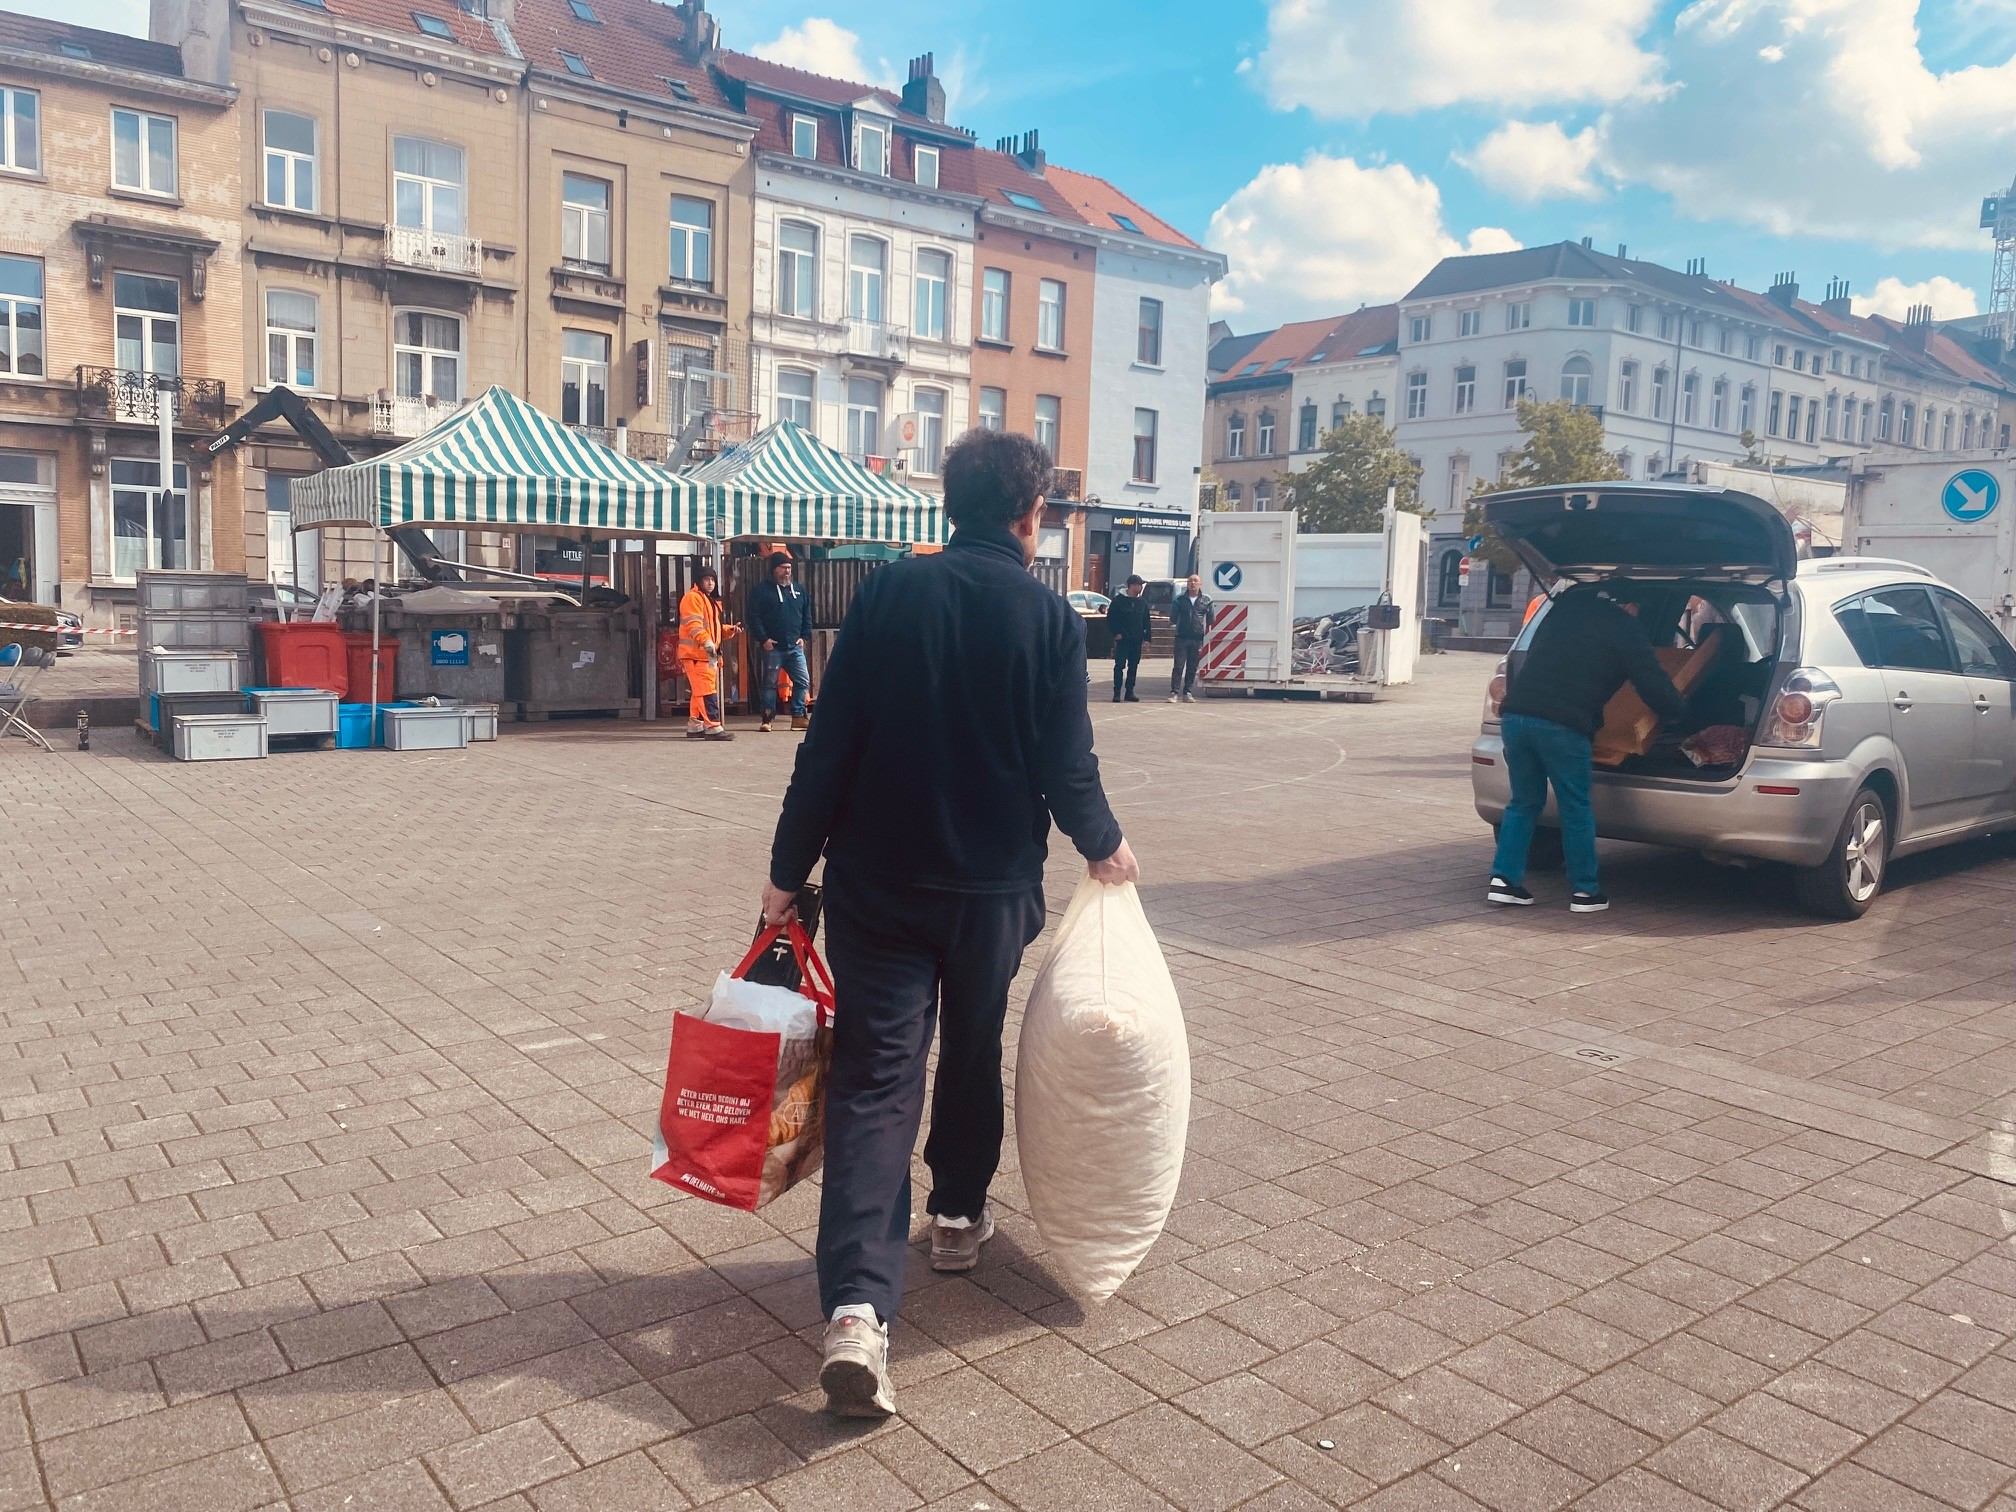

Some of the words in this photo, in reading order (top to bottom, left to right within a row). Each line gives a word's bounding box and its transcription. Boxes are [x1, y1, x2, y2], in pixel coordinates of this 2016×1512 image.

[1576, 1049, 1620, 1061] G6
[680, 1087, 697, 1100] BETER
[698, 1092, 717, 1102] LEVEN
[678, 1107, 688, 1117] WE
[688, 1109, 701, 1119] MET
[701, 1112, 715, 1122] HEEL
[715, 1115, 729, 1125] ONS
[689, 1176, 716, 1196] DELHAIZE
